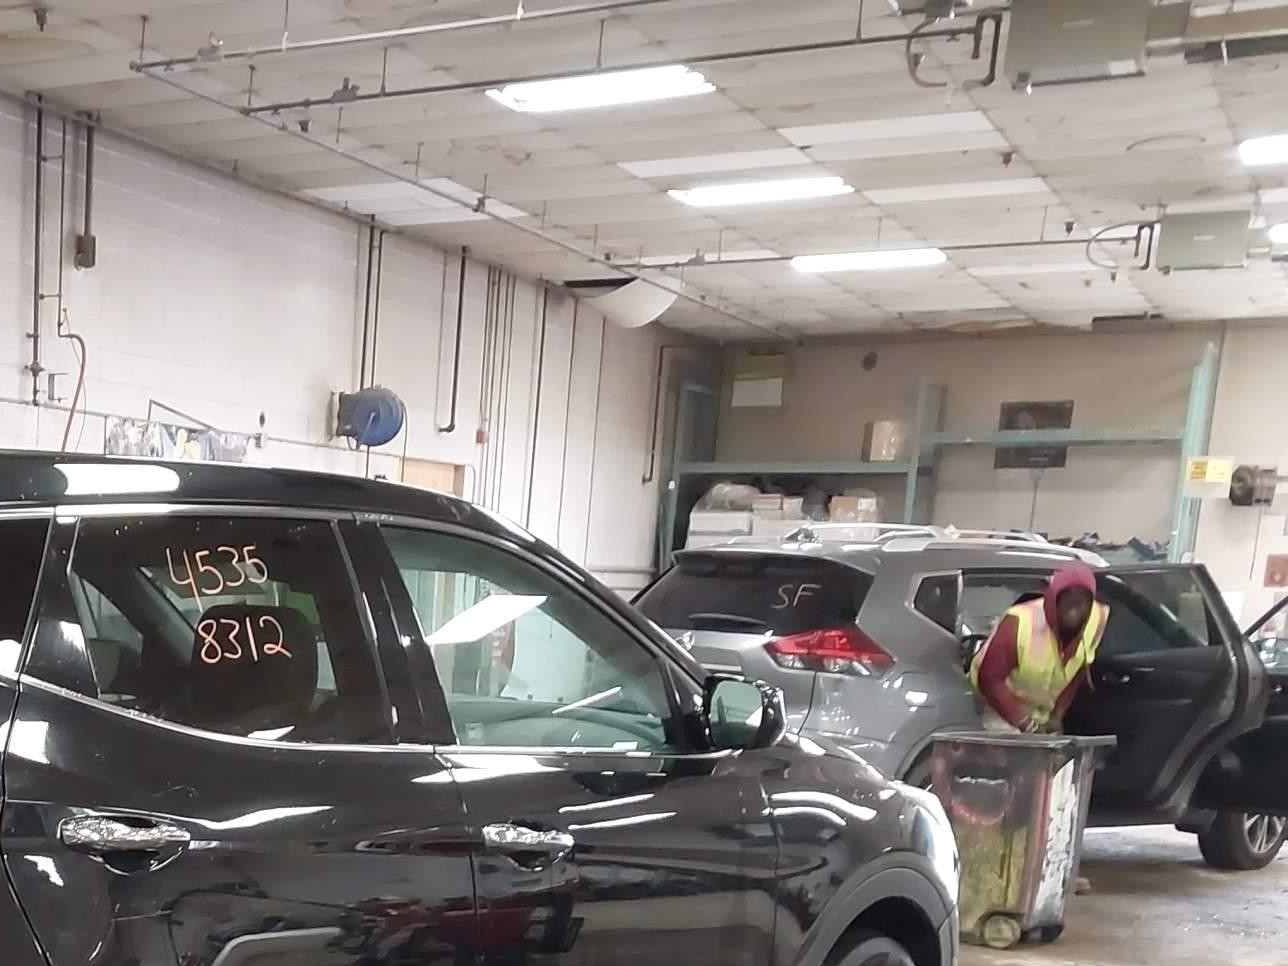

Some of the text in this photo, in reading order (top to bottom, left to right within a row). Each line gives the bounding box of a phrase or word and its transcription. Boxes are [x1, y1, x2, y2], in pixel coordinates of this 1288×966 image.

[165, 545, 268, 613] 4535
[770, 583, 822, 609] SF
[197, 615, 292, 664] 8312
